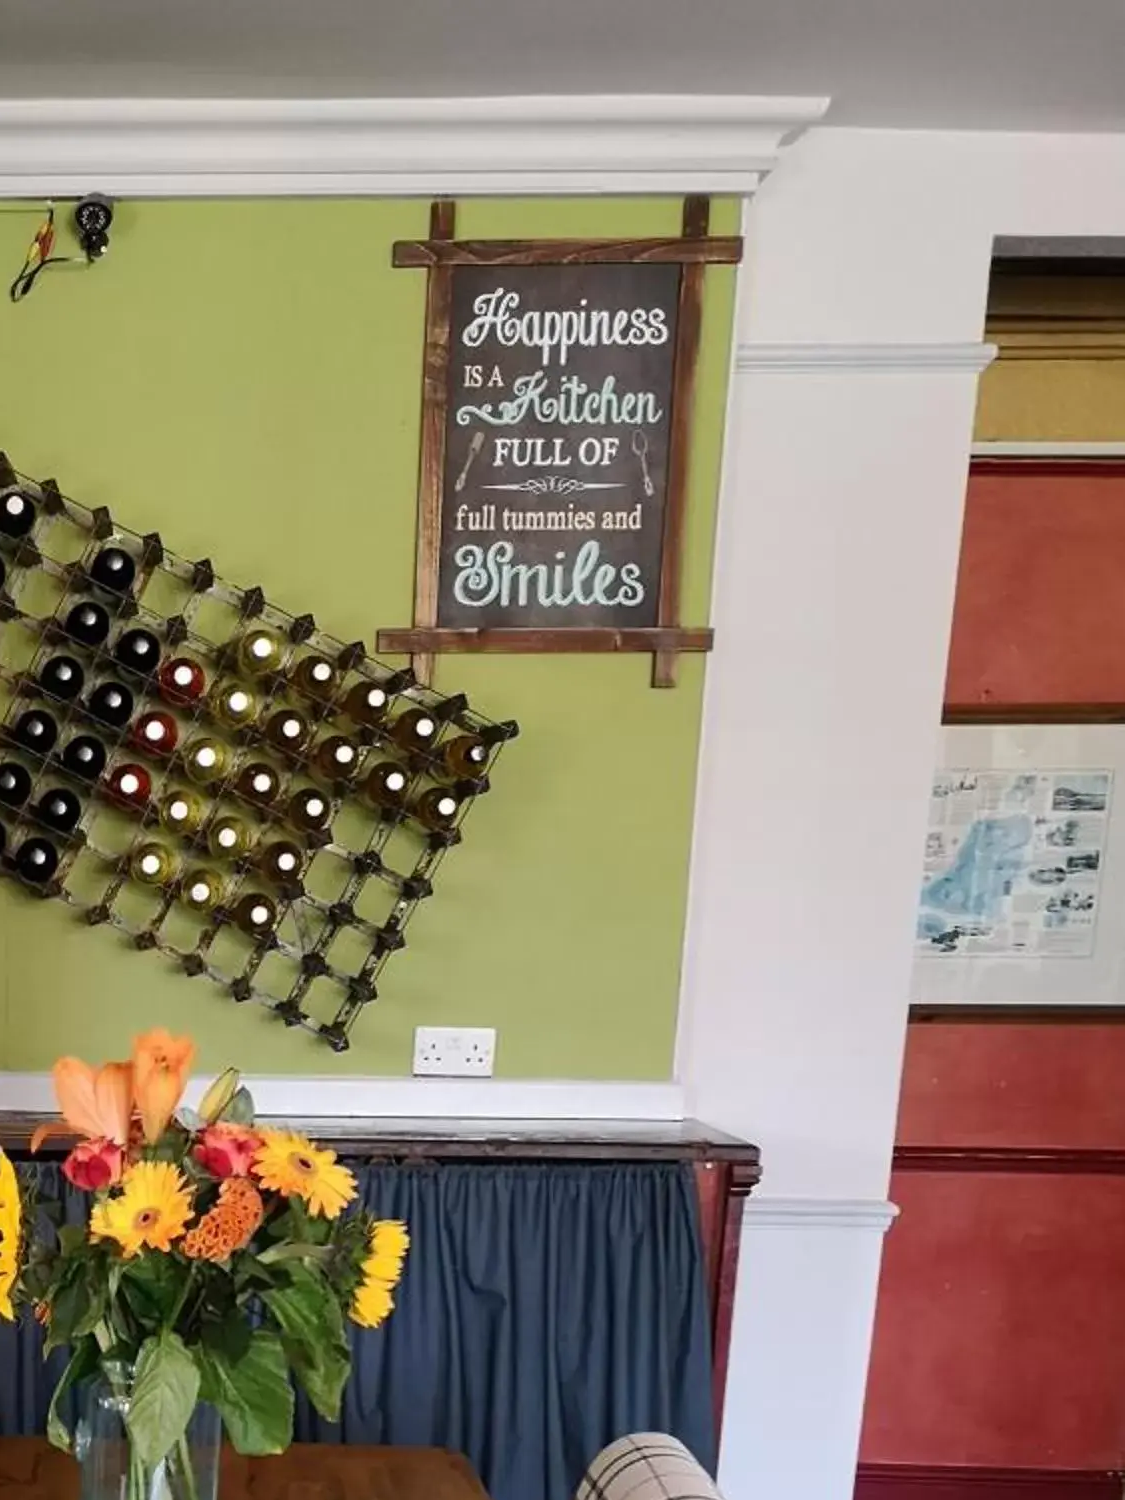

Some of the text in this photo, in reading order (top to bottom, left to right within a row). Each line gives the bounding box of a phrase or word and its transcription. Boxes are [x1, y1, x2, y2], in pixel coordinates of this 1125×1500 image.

[462, 287, 669, 366] Happiness
[456, 365, 663, 426] IS A Kitchen
[493, 437, 620, 467] FULL OF
[456, 504, 643, 532] full tummies and
[454, 540, 645, 608] Smiles
